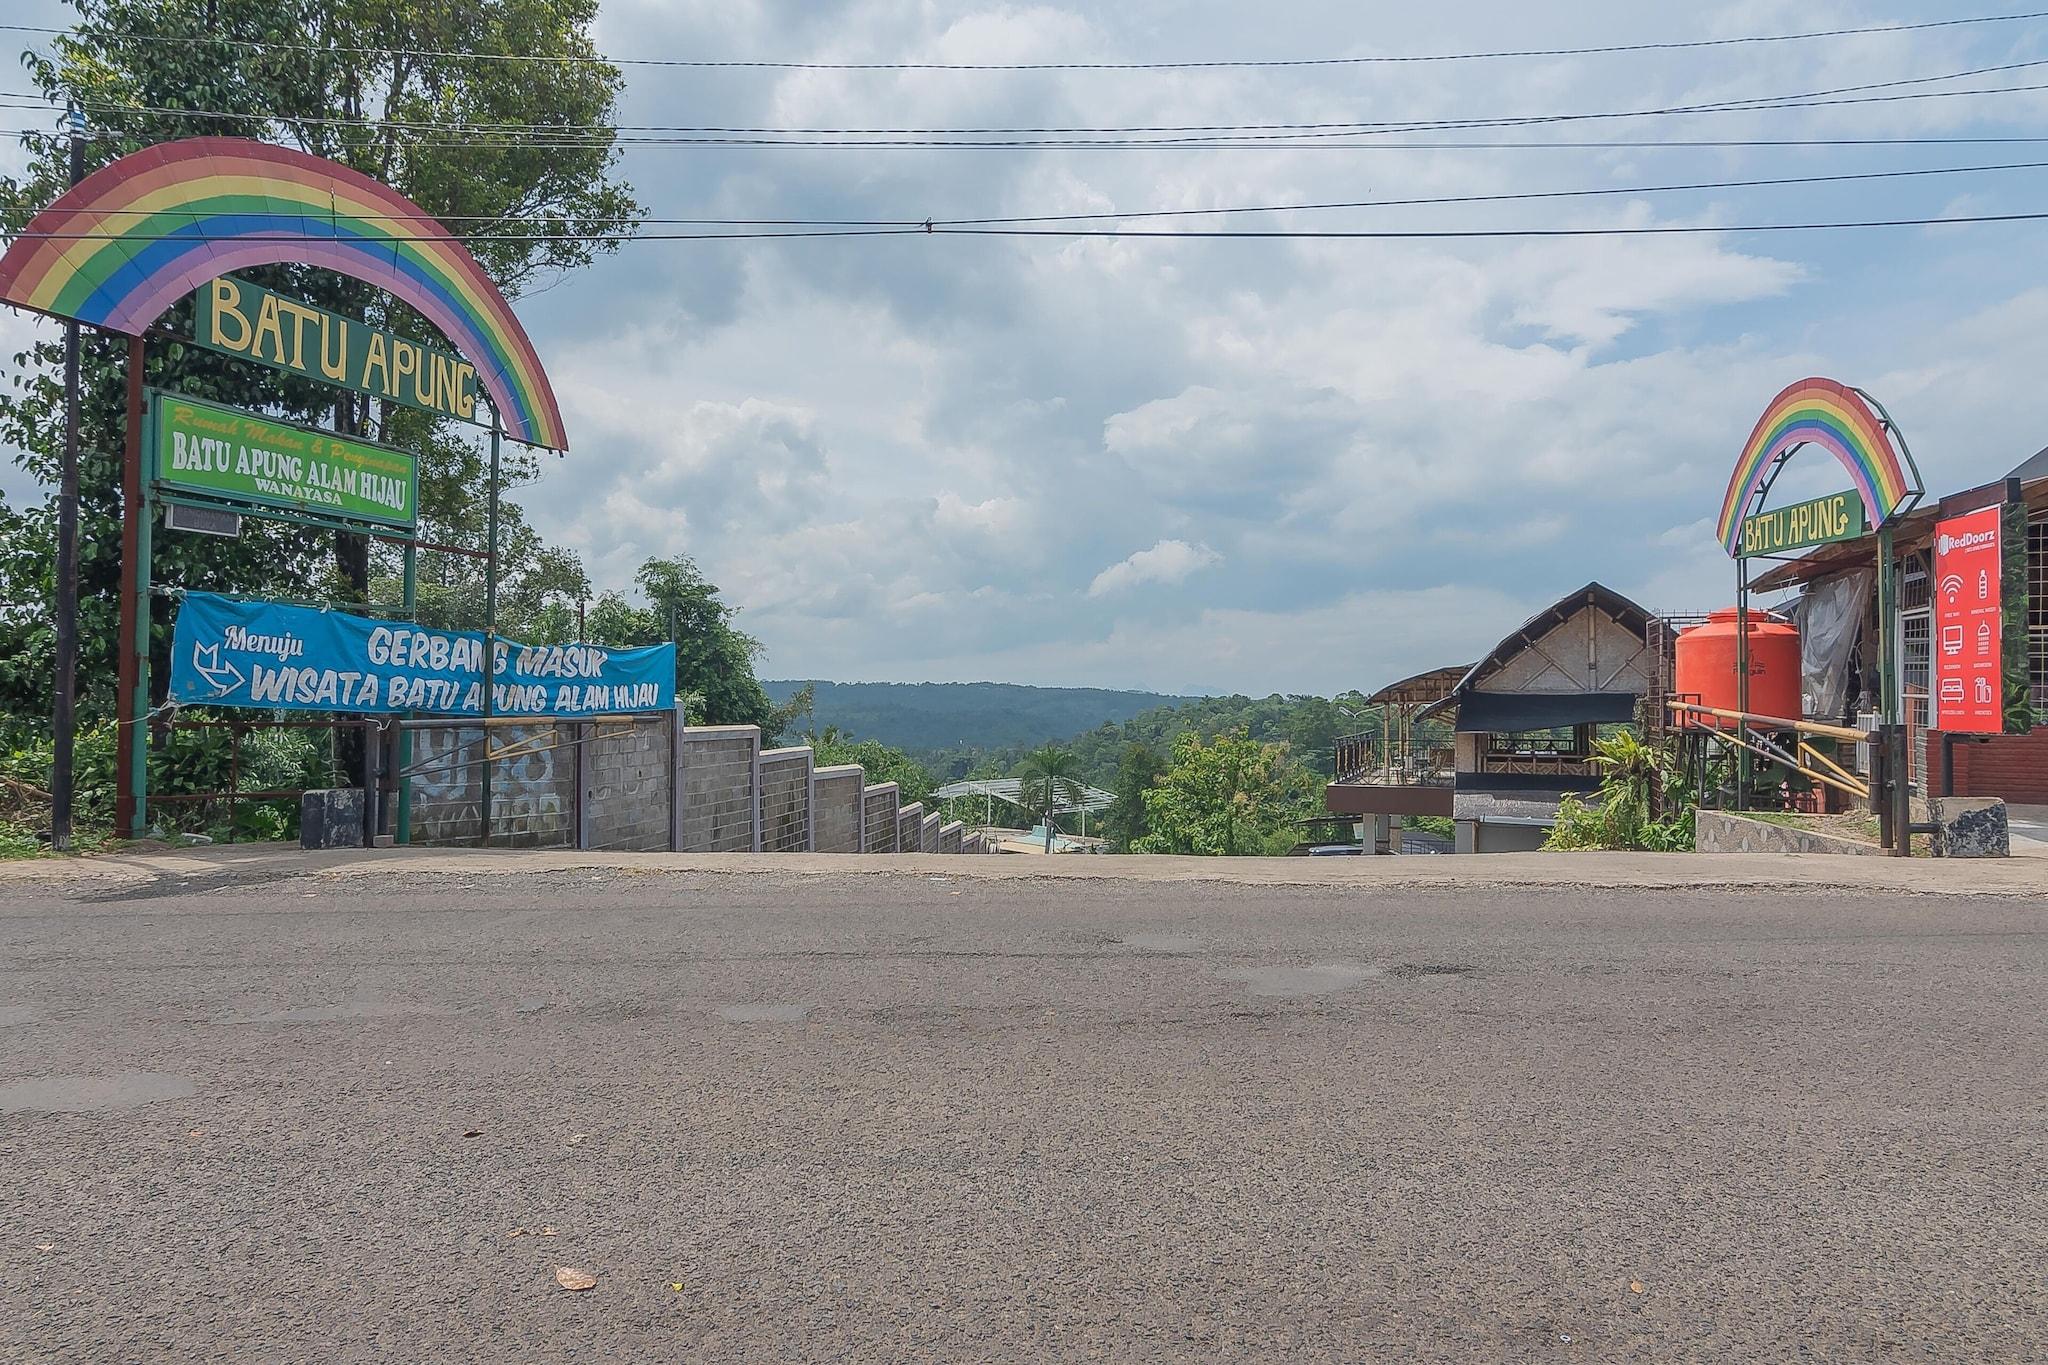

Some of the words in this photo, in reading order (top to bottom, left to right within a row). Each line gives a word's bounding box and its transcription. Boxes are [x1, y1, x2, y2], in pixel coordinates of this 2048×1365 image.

[211, 276, 348, 382] BATU
[361, 331, 476, 418] APUNG
[174, 406, 240, 436] Rumah
[244, 423, 304, 450] Makan
[311, 438, 323, 454] &
[172, 431, 231, 472] BATU
[235, 445, 303, 482] APUNG
[306, 460, 357, 495] ALAM
[360, 471, 407, 511] HIJAU
[254, 477, 344, 506] WANAYASA
[1745, 511, 1784, 553] BATU
[1788, 496, 1849, 546] APUNG
[1948, 530, 1996, 550] RedDoorz
[224, 625, 304, 663] Menuju
[367, 626, 510, 676] GERBANG
[515, 646, 609, 679] MASUK
[251, 663, 379, 707] WISATA
[388, 675, 461, 711] BATU
[553, 685, 610, 713] ALAM
[613, 682, 660, 710] HIJAU
